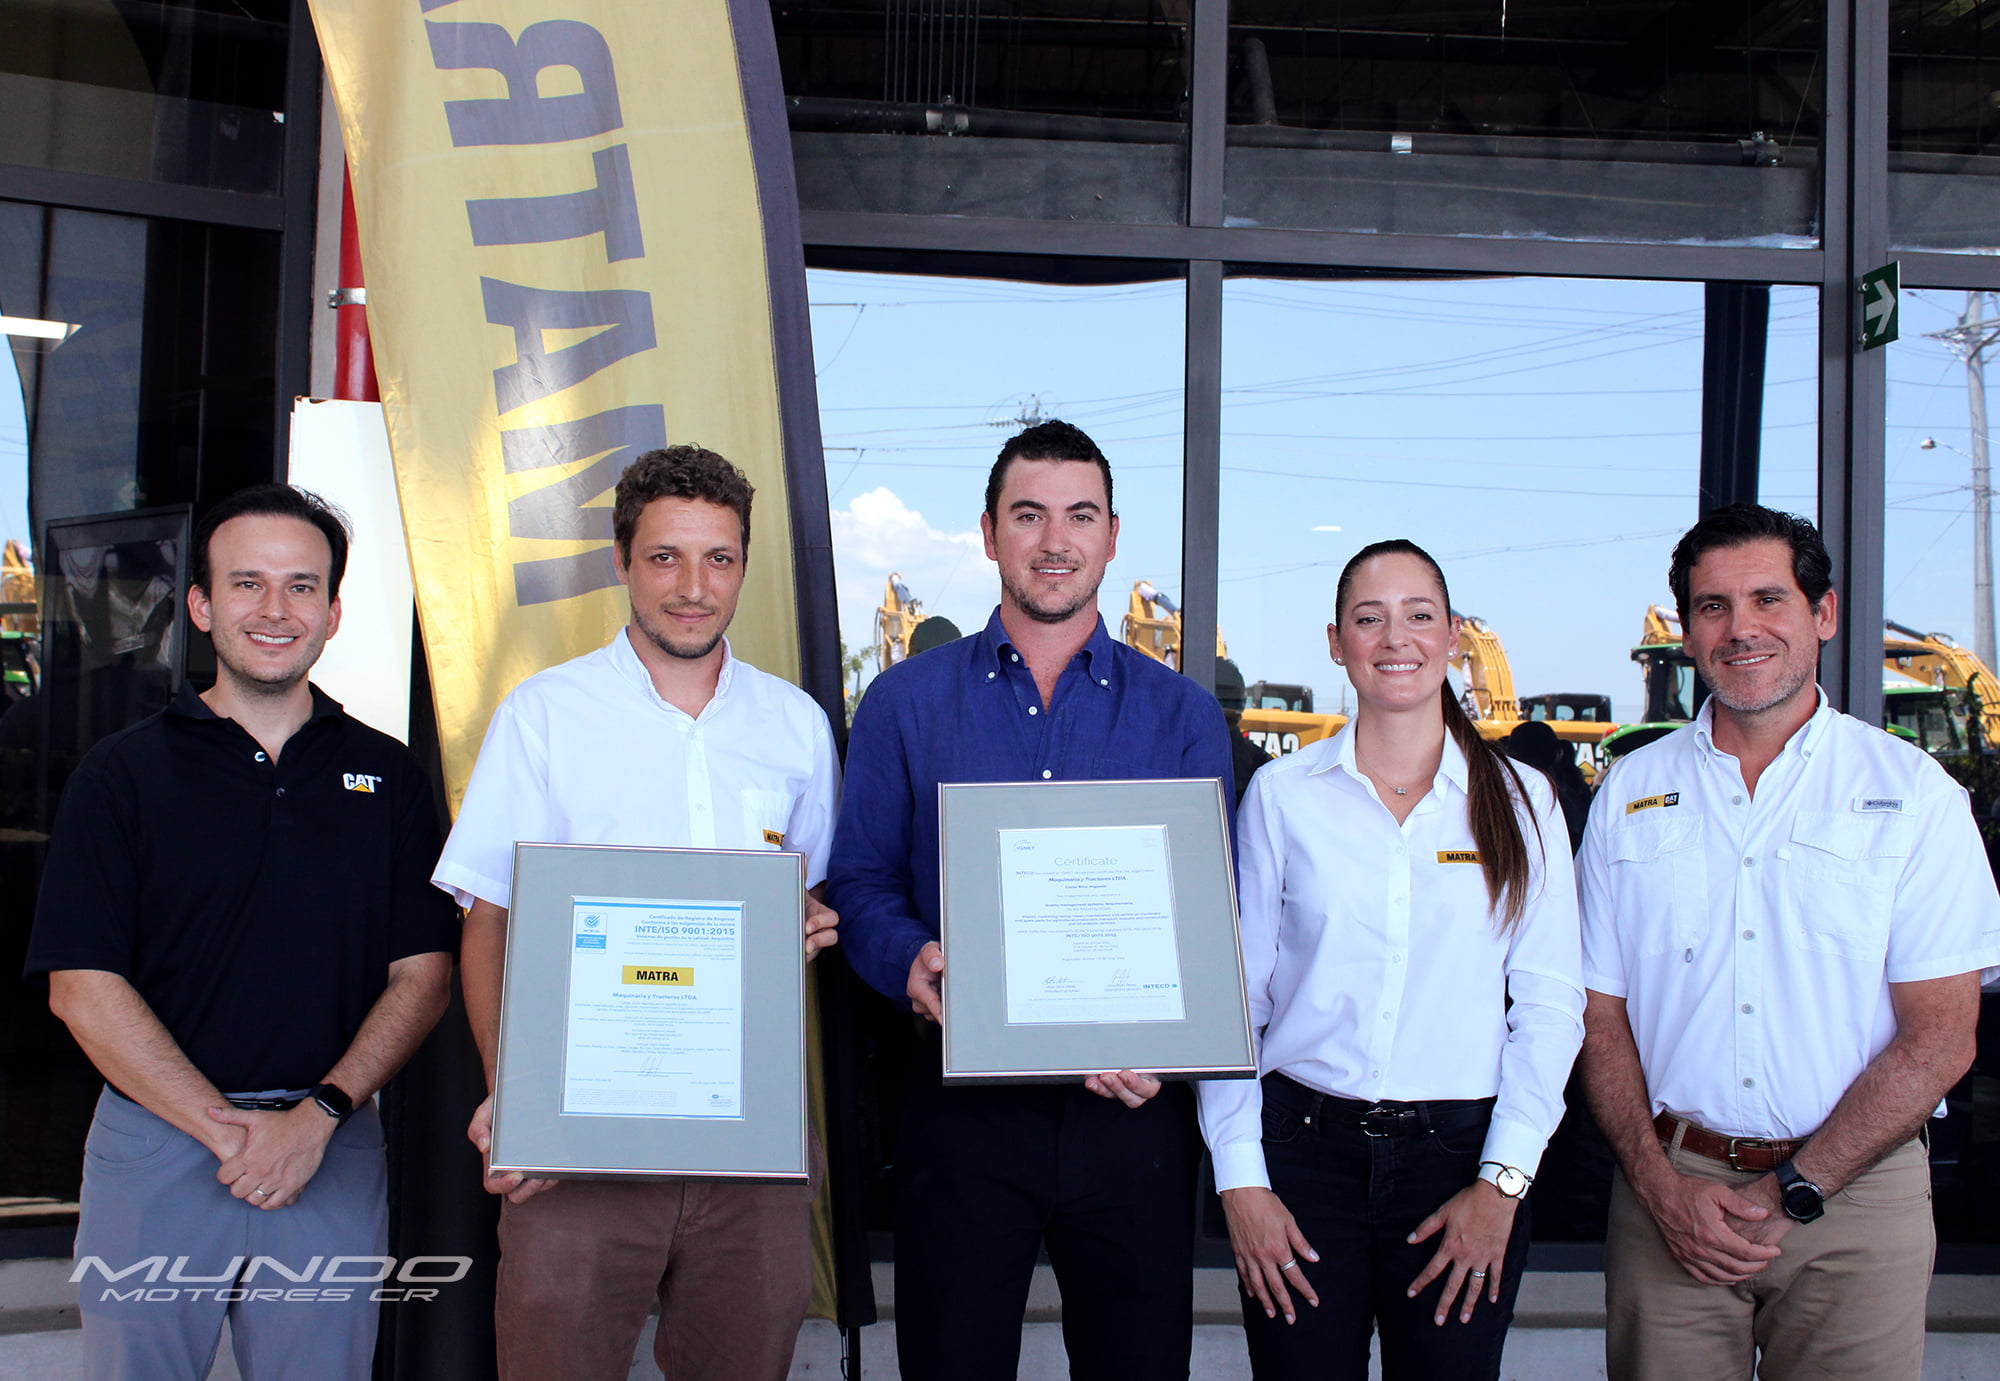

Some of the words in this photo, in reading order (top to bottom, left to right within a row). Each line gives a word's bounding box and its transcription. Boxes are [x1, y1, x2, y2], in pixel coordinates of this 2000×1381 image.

[342, 773, 376, 793] CAT
[1632, 798, 1659, 810] MATRA
[1665, 795, 1678, 804] CAT
[1054, 856, 1119, 866] Certificate
[1446, 853, 1477, 862] MATRA
[634, 925, 679, 935] INTE/ISO
[681, 927, 736, 936] 9001:2015
[636, 970, 679, 982] MATRA
[612, 992, 646, 1000] Maquinaria
[652, 993, 680, 1001] Tractores
